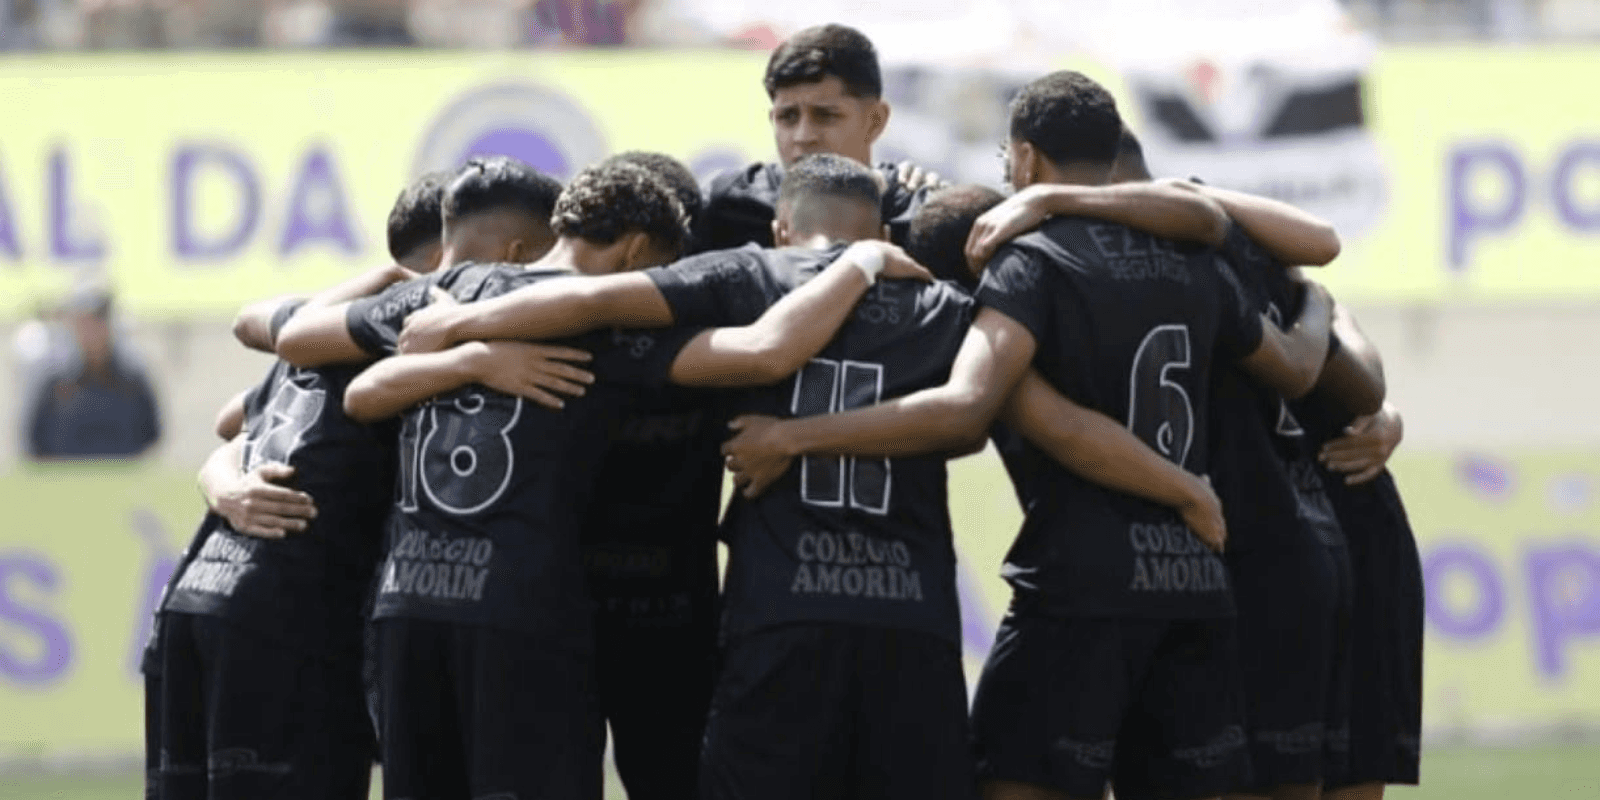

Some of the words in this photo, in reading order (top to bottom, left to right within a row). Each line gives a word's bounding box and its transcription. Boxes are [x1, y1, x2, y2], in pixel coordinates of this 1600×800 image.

[169, 145, 363, 262] DA
[790, 356, 892, 516] 11
[1126, 323, 1195, 469] 6
[789, 562, 924, 603] AMORIM
